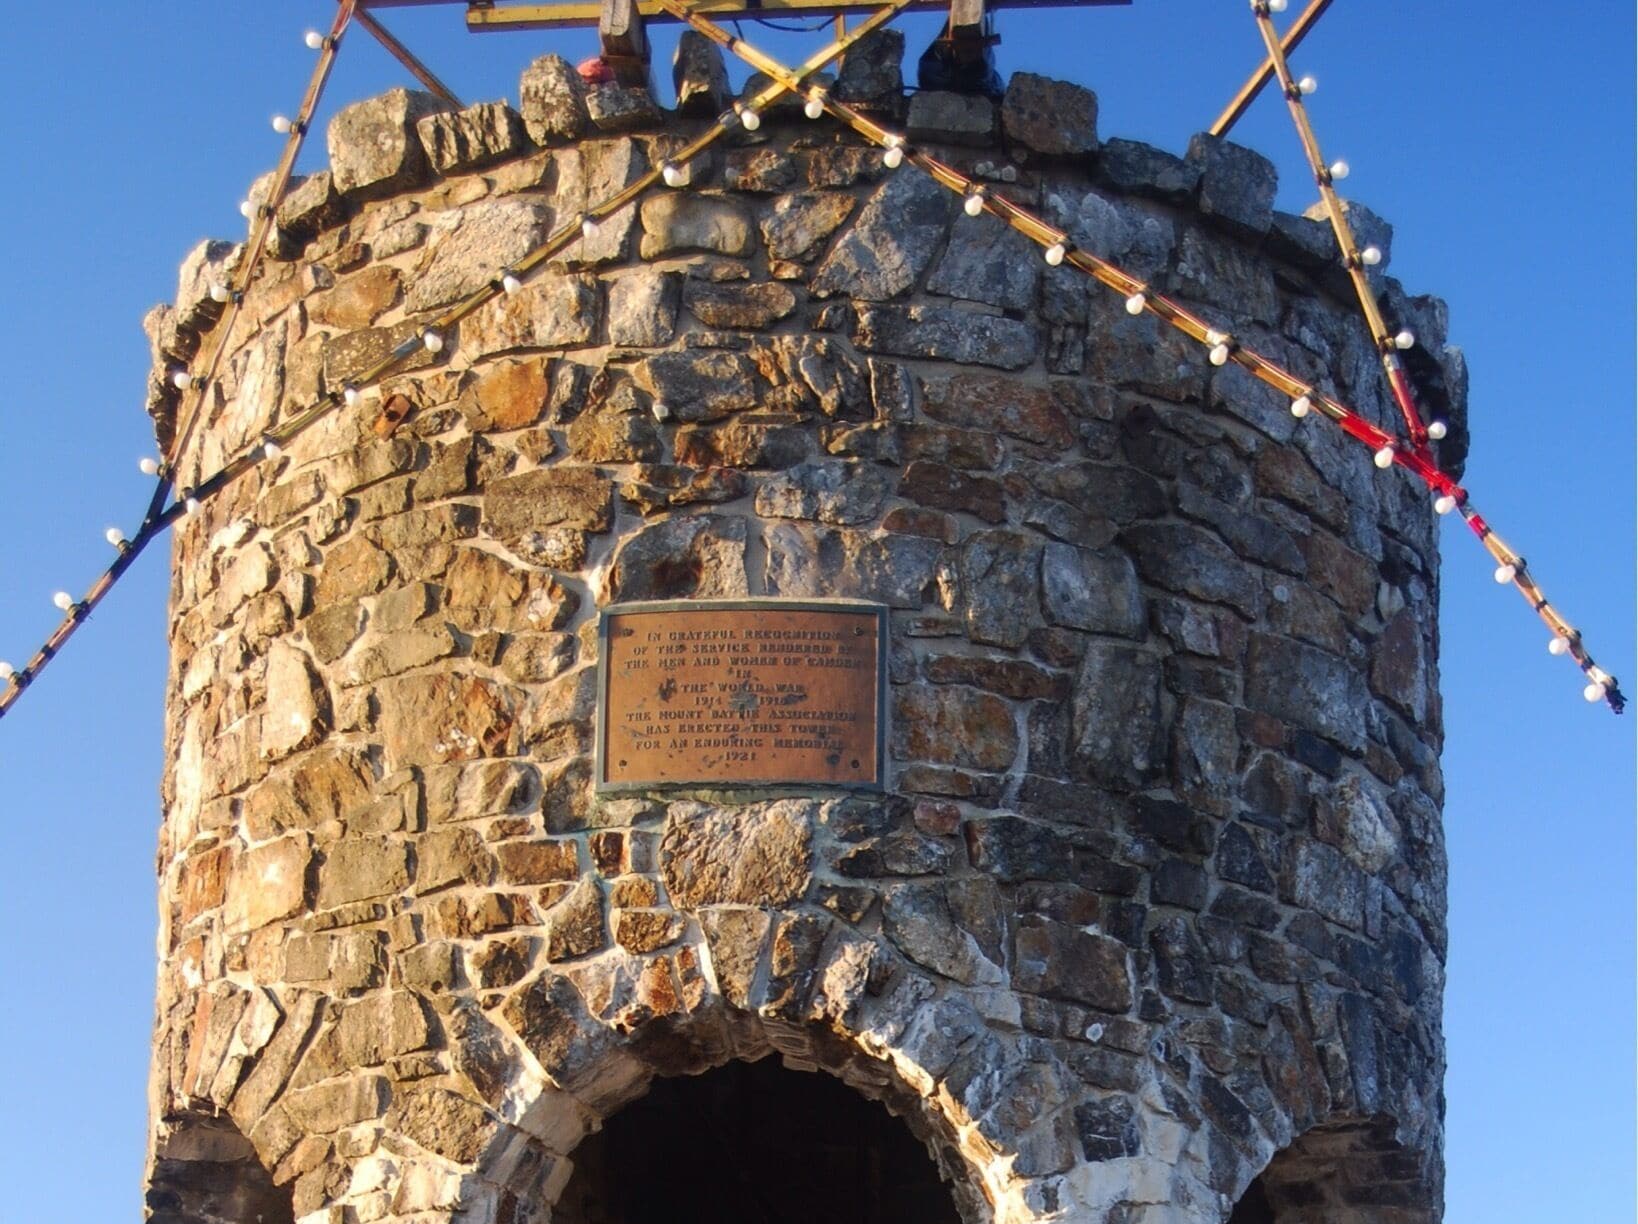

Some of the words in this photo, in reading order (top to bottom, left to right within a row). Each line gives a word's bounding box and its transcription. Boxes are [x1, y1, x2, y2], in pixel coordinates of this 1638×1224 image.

[647, 631, 661, 641] IN
[669, 630, 737, 641] GRATEFUL
[633, 645, 649, 656] OF
[656, 644, 685, 655] THE
[692, 643, 750, 654] SERVICE
[624, 659, 649, 669] THE
[658, 658, 686, 668] MEN
[693, 657, 720, 667] AND
[730, 656, 778, 667] WOMEN
[783, 656, 801, 667] OF
[736, 669, 752, 679] IN
[681, 683, 708, 693] THE
[695, 696, 722, 706] 1914
[625, 711, 652, 722] THE
[658, 710, 704, 720] MOUNT
[646, 724, 671, 735] HAS
[678, 723, 741, 734] ERECTED
[750, 723, 781, 734] THIS
[635, 740, 662, 751] FOR
[669, 738, 688, 749] AN
[694, 738, 763, 749] ENDURING
